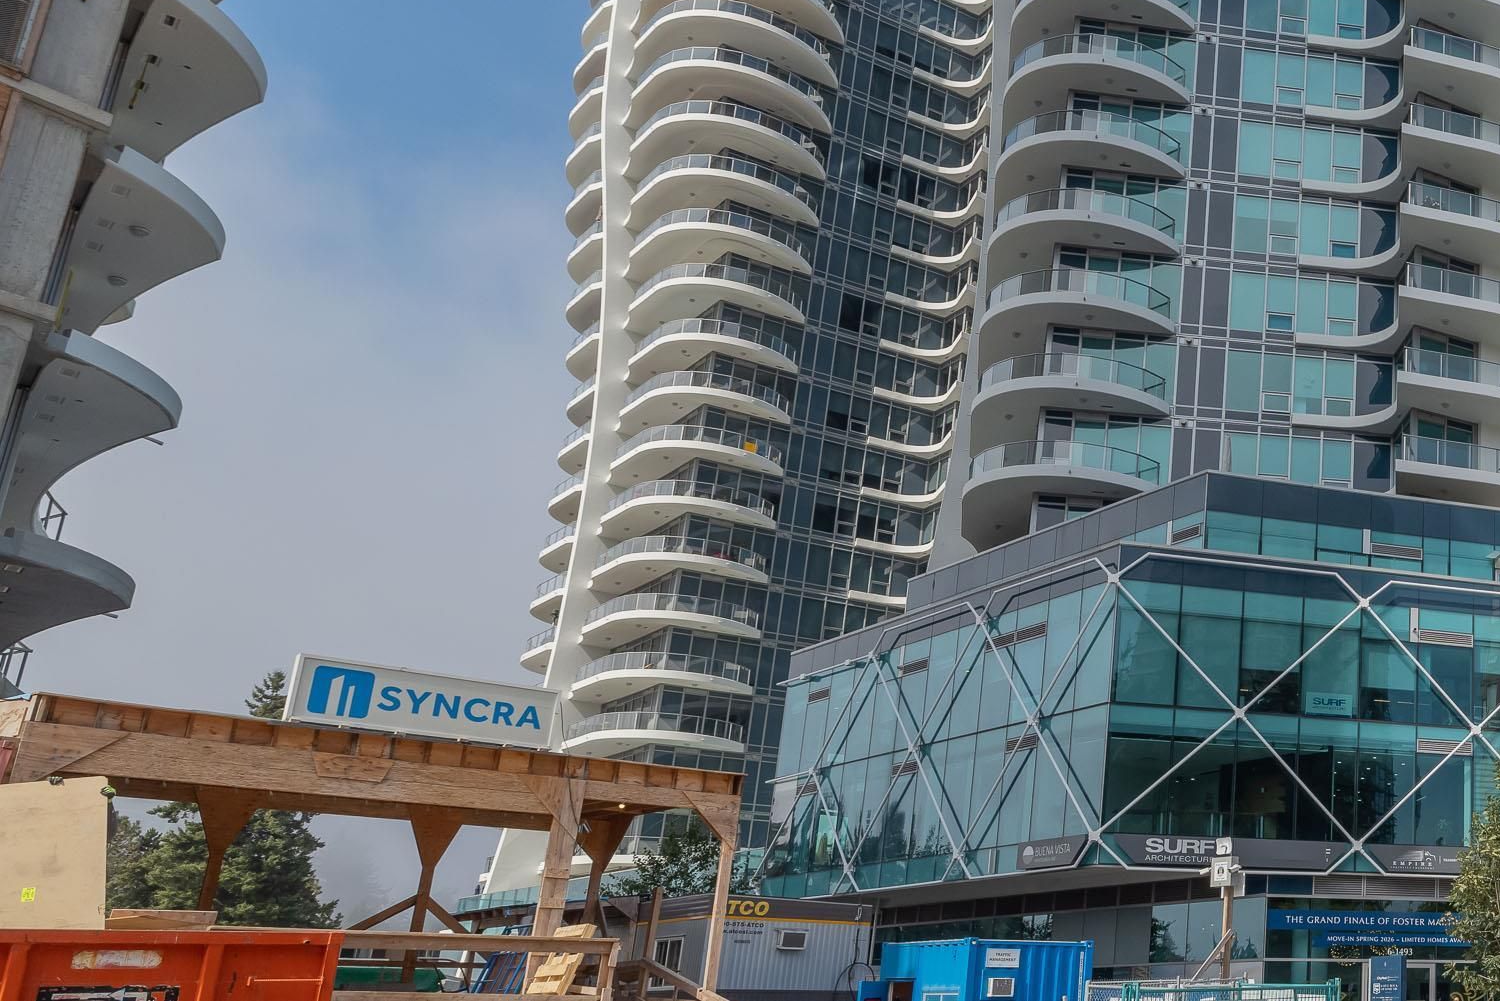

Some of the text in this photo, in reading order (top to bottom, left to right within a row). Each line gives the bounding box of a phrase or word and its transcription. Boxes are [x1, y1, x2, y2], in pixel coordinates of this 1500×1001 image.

[377, 685, 541, 730] SYNCRA
[1312, 696, 1347, 706] SURF
[1054, 842, 1071, 854] VISTA
[1145, 837, 1215, 854] SURF
[727, 900, 770, 916] TCO
[1285, 915, 1304, 924] THE
[1307, 916, 1341, 925] GRAND
[1343, 916, 1375, 925] FINALE
[1377, 917, 1390, 925] OF
[1393, 917, 1425, 926] FOSTER
